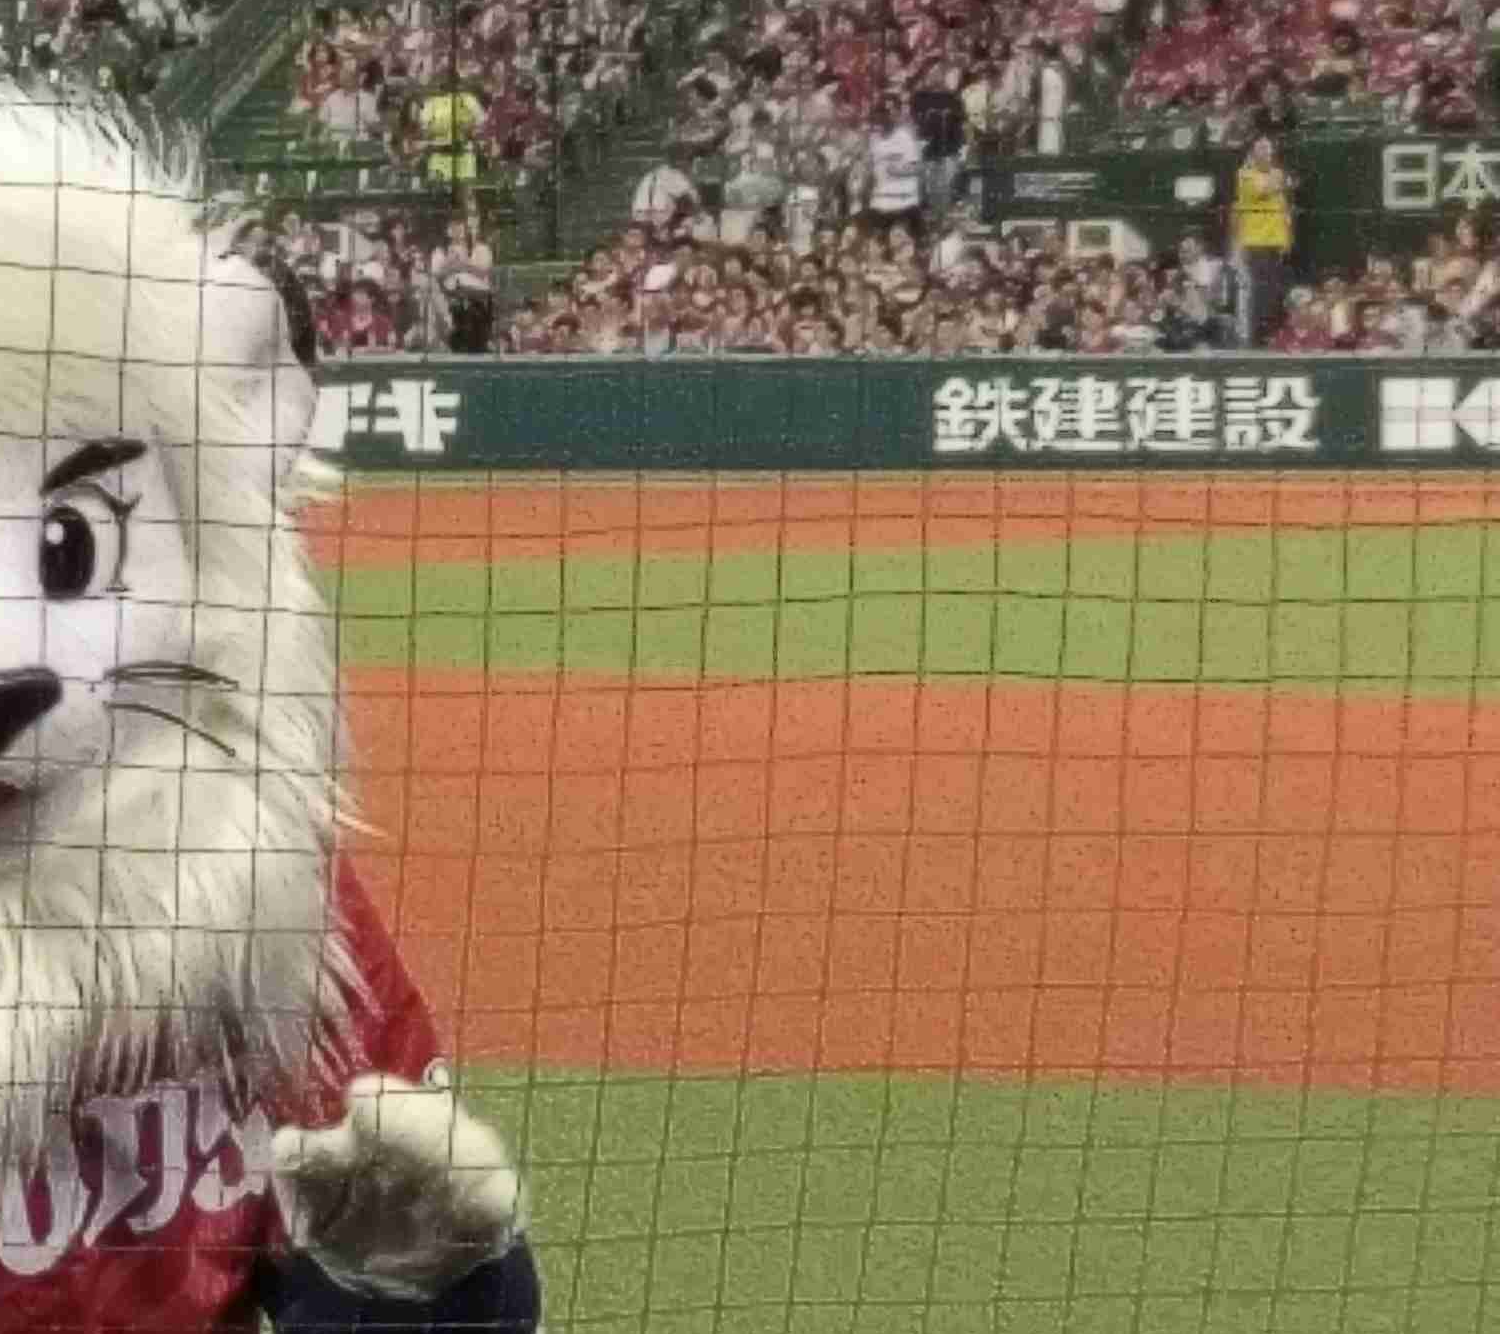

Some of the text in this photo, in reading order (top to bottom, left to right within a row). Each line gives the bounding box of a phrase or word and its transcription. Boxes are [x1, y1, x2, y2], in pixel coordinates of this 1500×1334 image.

[1383, 143, 1500, 210] 日本
[932, 376, 1321, 451] 鉄建建設
